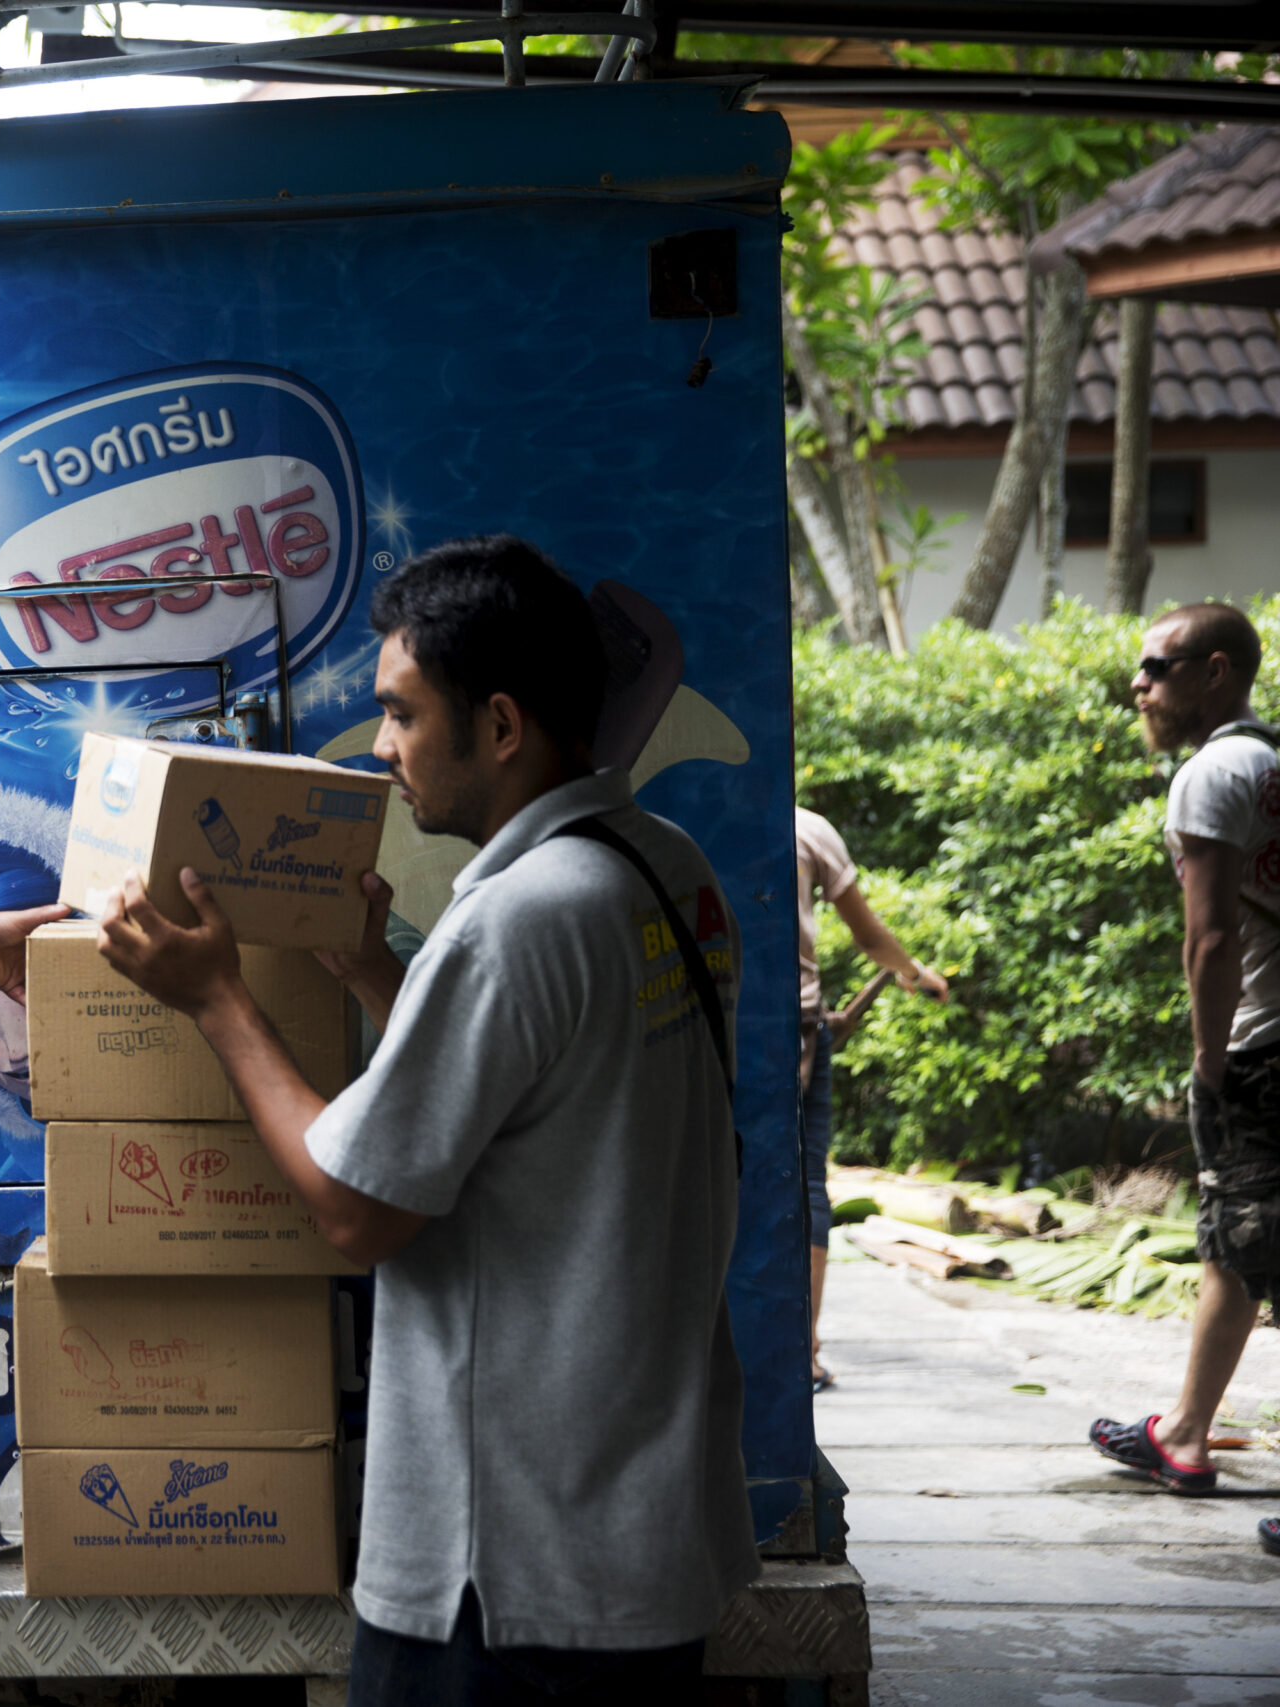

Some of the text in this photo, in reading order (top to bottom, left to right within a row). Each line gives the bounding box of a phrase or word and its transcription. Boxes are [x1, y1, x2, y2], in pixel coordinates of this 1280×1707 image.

[19, 395, 236, 497] ไอศกรีม
[9, 485, 331, 654] Nestlé
[148, 1501, 278, 1529] มิ้นท์ช็อกโคน
